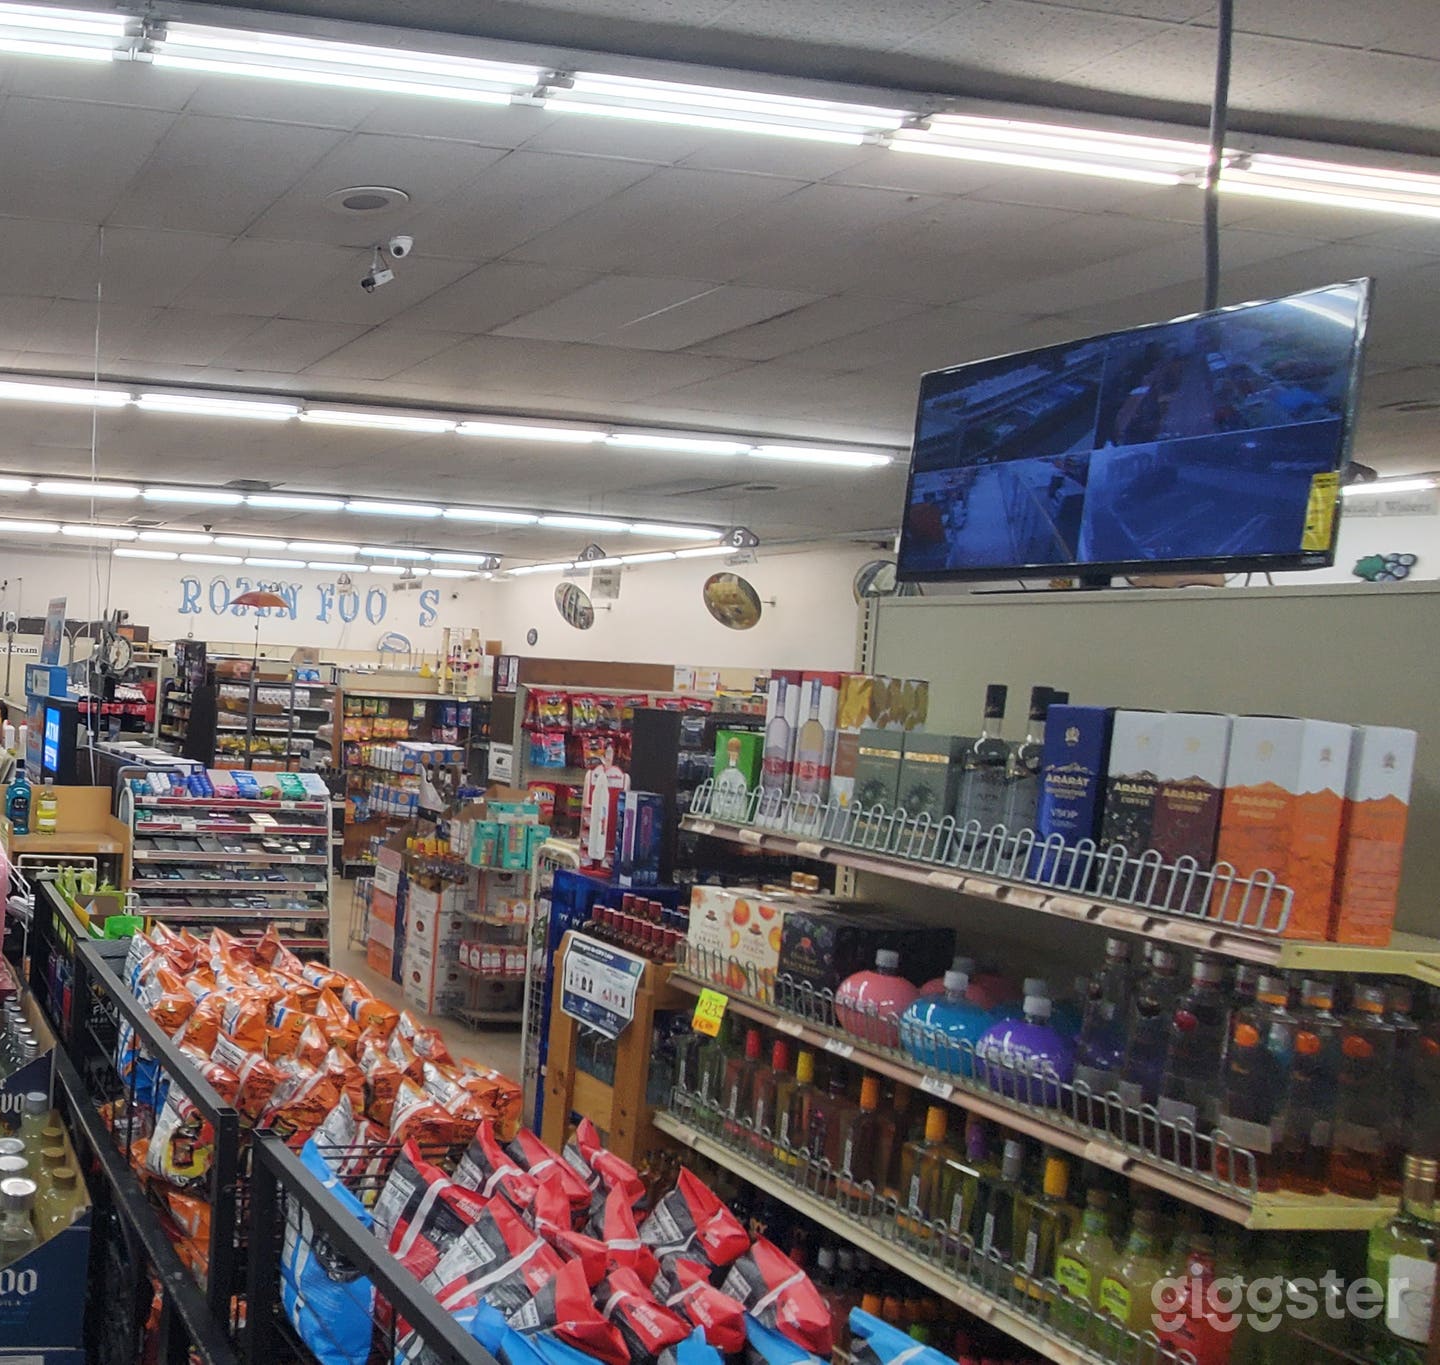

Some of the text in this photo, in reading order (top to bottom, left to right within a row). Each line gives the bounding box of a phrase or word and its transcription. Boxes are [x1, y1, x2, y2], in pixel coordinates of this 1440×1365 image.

[732, 530, 743, 546] 5
[587, 549, 594, 559] 6
[9, 645, 38, 654] Cream
[1045, 773, 1091, 786] ARARAT
[1162, 787, 1212, 801] ARARAT
